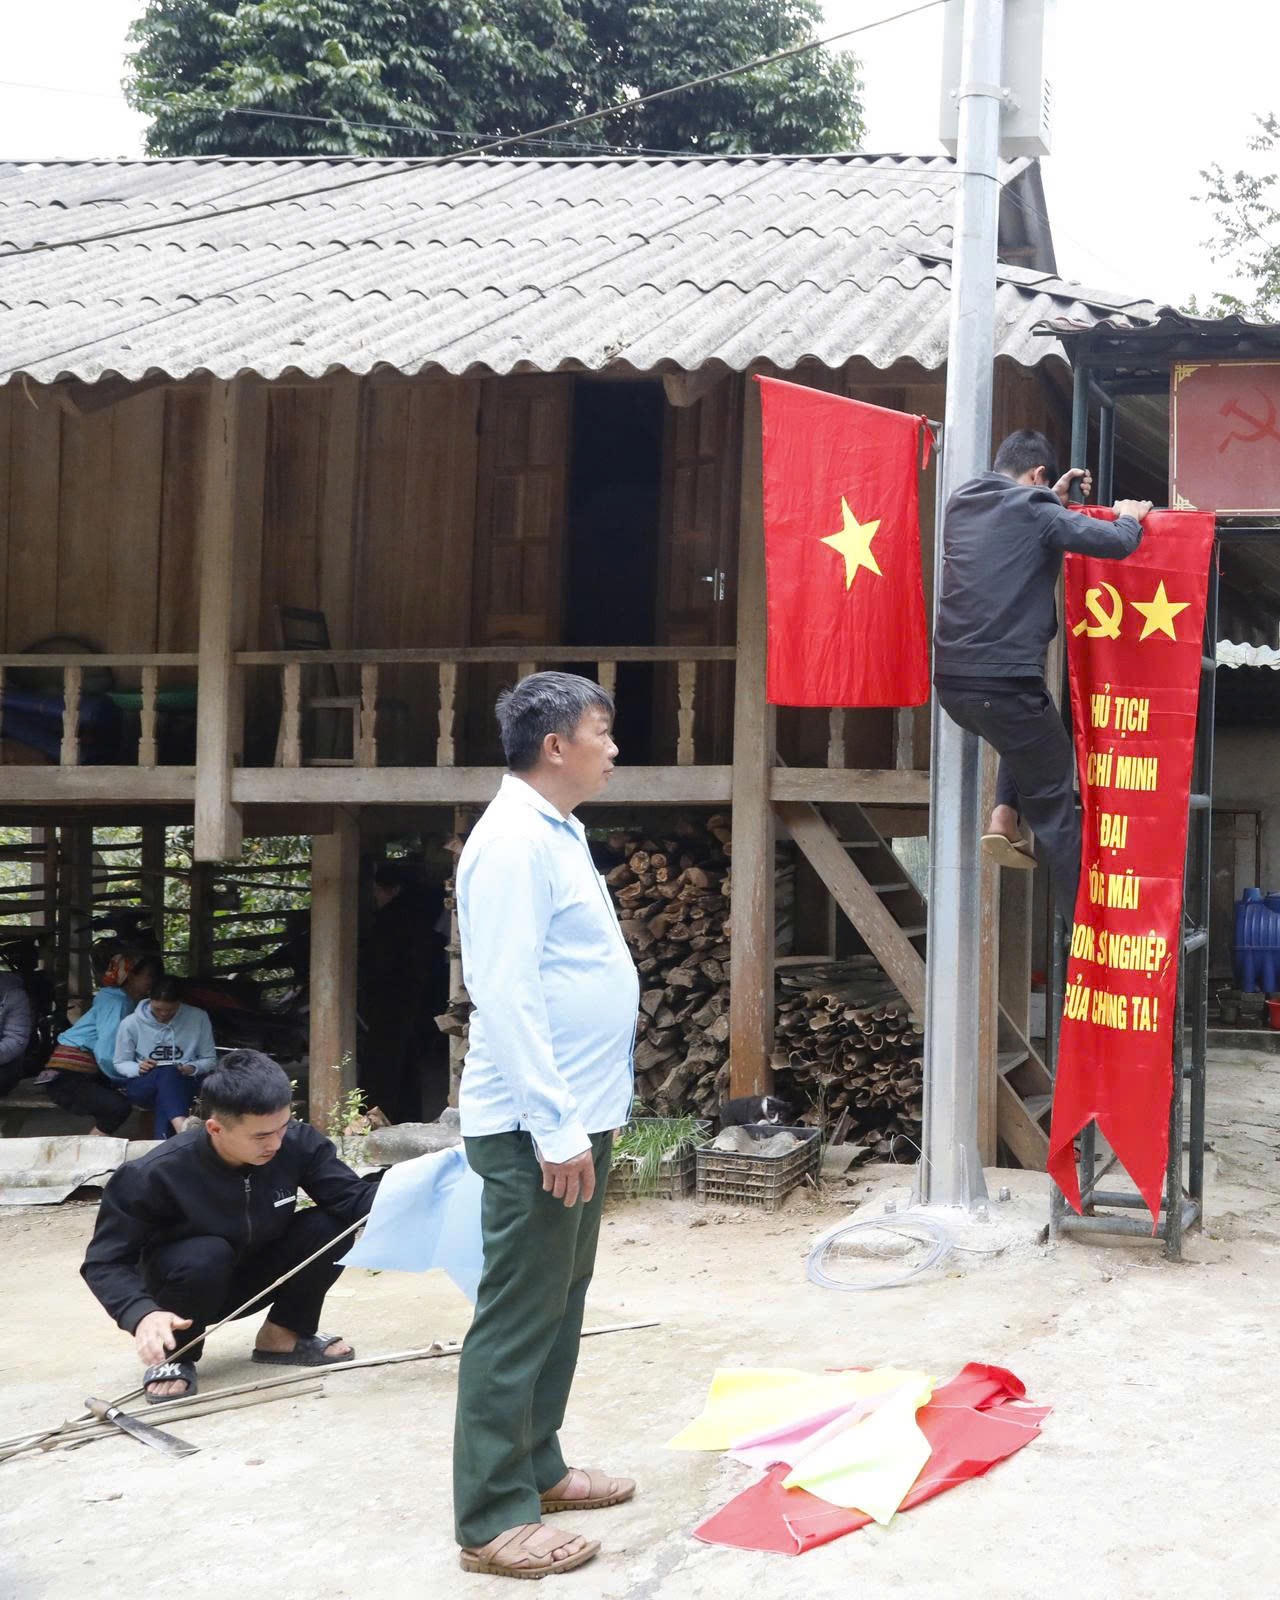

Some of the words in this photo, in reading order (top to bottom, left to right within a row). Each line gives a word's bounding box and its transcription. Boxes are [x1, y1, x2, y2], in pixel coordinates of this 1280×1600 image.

[1090, 683, 1111, 729] HỦ
[1114, 696, 1150, 739] TỊCH
[1115, 755, 1158, 791] MINH
[1100, 813, 1128, 856] ĐẠI
[1107, 868, 1140, 910] MÃI
[1108, 929, 1167, 979] NGHIỆP
